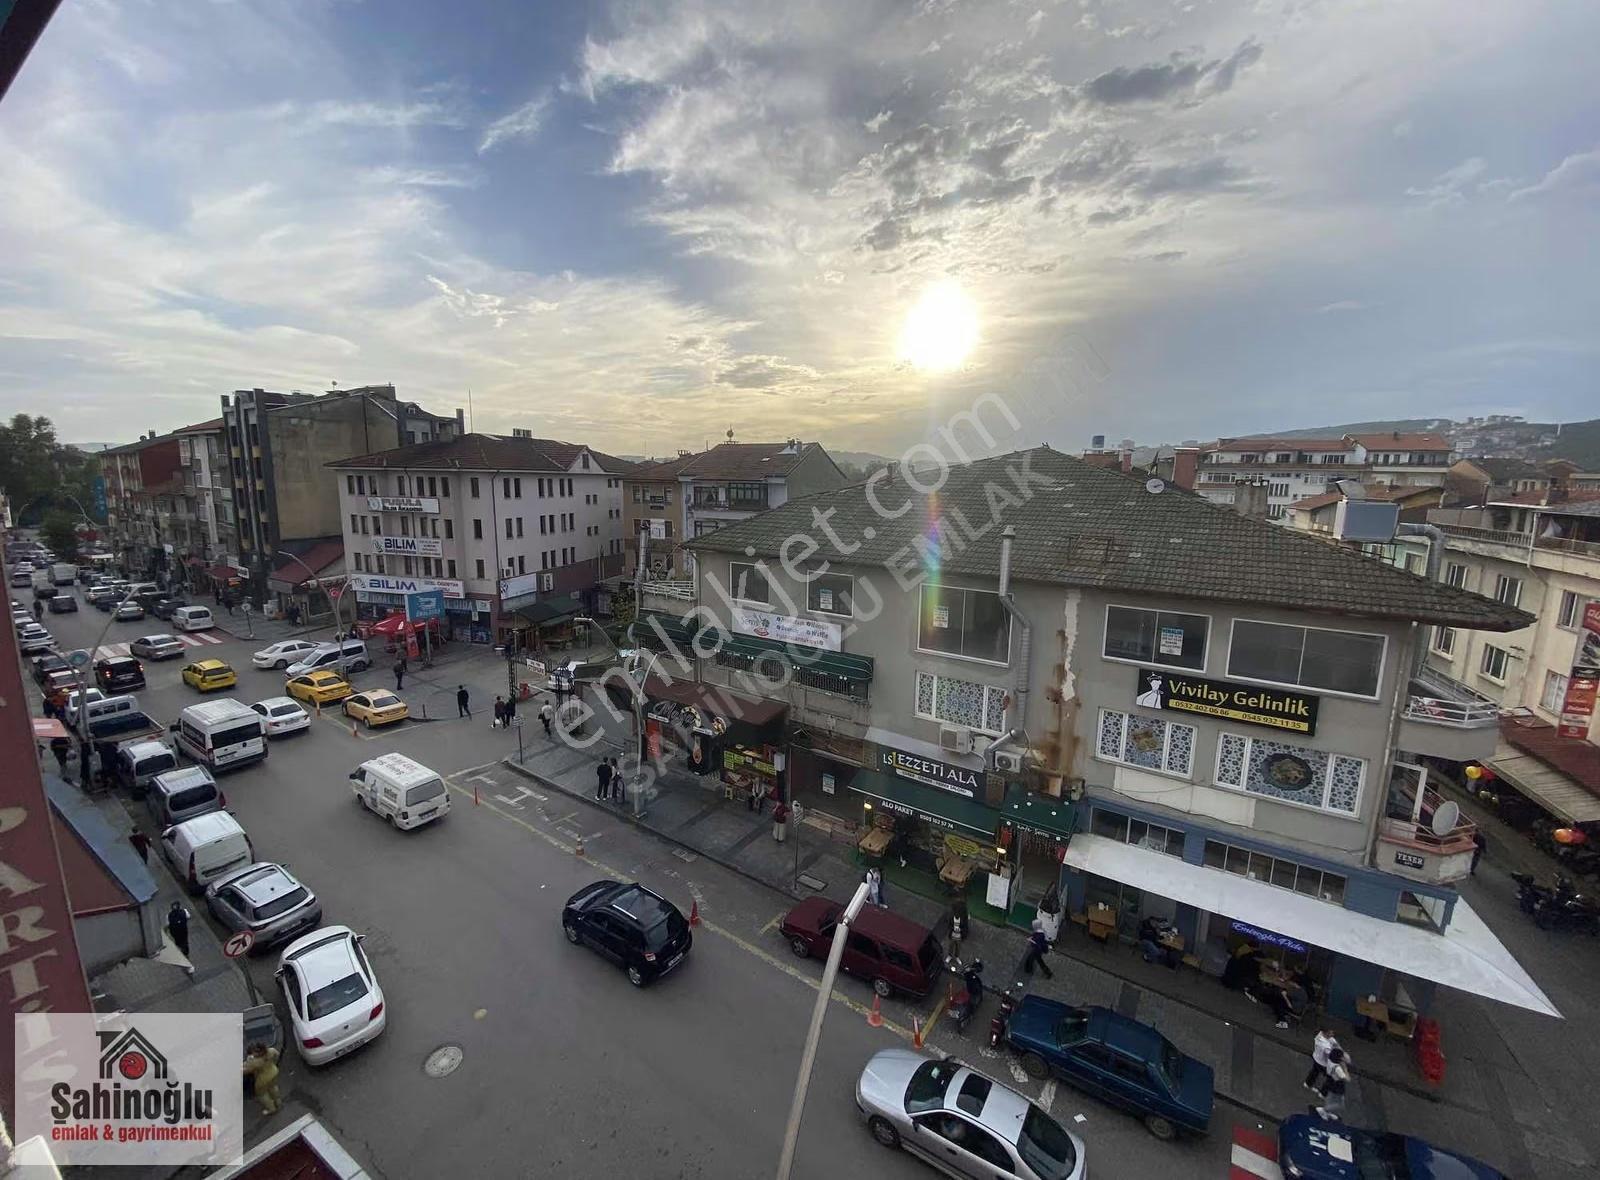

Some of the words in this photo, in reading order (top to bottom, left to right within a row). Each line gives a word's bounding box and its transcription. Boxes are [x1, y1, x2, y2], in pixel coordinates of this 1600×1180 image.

[1169, 679, 1229, 706] Vivilay
[1233, 691, 1309, 717] Gelinlik
[1174, 701, 1193, 710] 0532
[1194, 704, 1208, 712] 402
[1242, 712, 1261, 722] 0545
[1263, 716, 1277, 725] 932
[1280, 719, 1290, 727] 11
[1290, 720, 1302, 729] 35
[881, 800, 894, 809] ALO
[894, 804, 913, 816] PAKET
